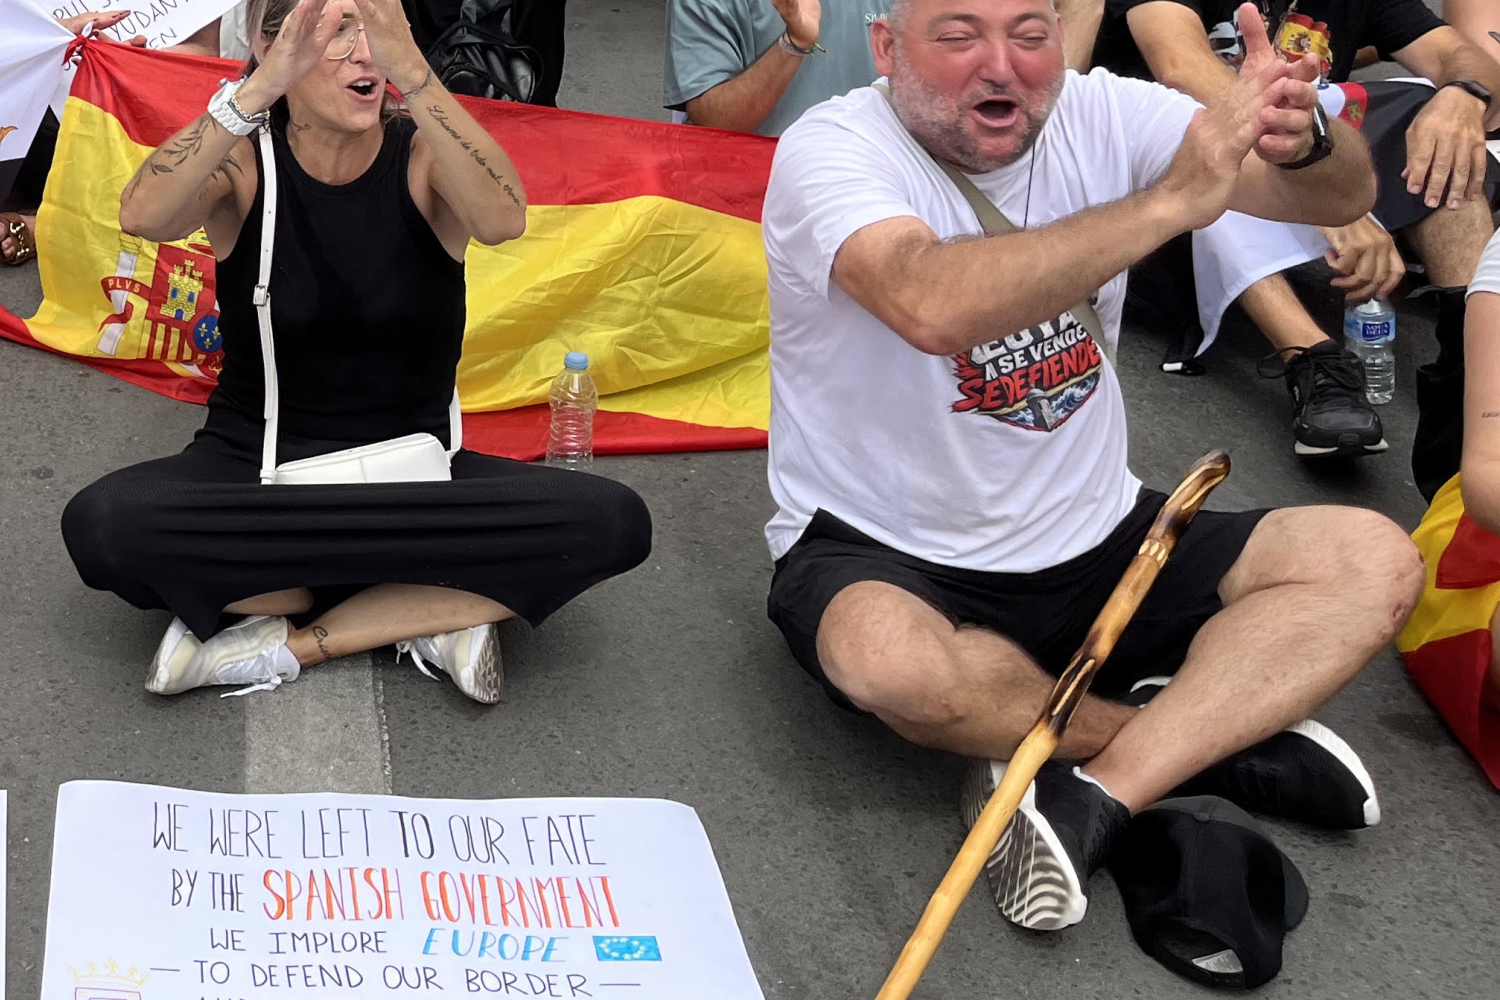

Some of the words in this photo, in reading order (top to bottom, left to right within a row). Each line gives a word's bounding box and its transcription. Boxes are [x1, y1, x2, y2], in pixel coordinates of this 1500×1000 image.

[108, 278, 141, 293] PLVS
[998, 350, 1029, 375] SE
[1029, 324, 1087, 362] VENDE
[152, 801, 189, 853] WE
[208, 805, 283, 859] WERE
[301, 807, 372, 859] LEFT
[397, 810, 435, 860] TO
[449, 814, 506, 865] OUR
[521, 814, 607, 866] FATE
[171, 868, 198, 908] BY
[207, 871, 245, 913] THE
[262, 866, 404, 922] SPANISH
[421, 870, 620, 928] GOVERNMENT
[210, 928, 246, 952] WE
[269, 931, 387, 954] IMPLORE
[423, 927, 570, 962] EUROPE
[194, 959, 230, 985] TO
[251, 963, 364, 989] DEFEND
[383, 964, 443, 990] OUR
[465, 969, 593, 998] BORDER
